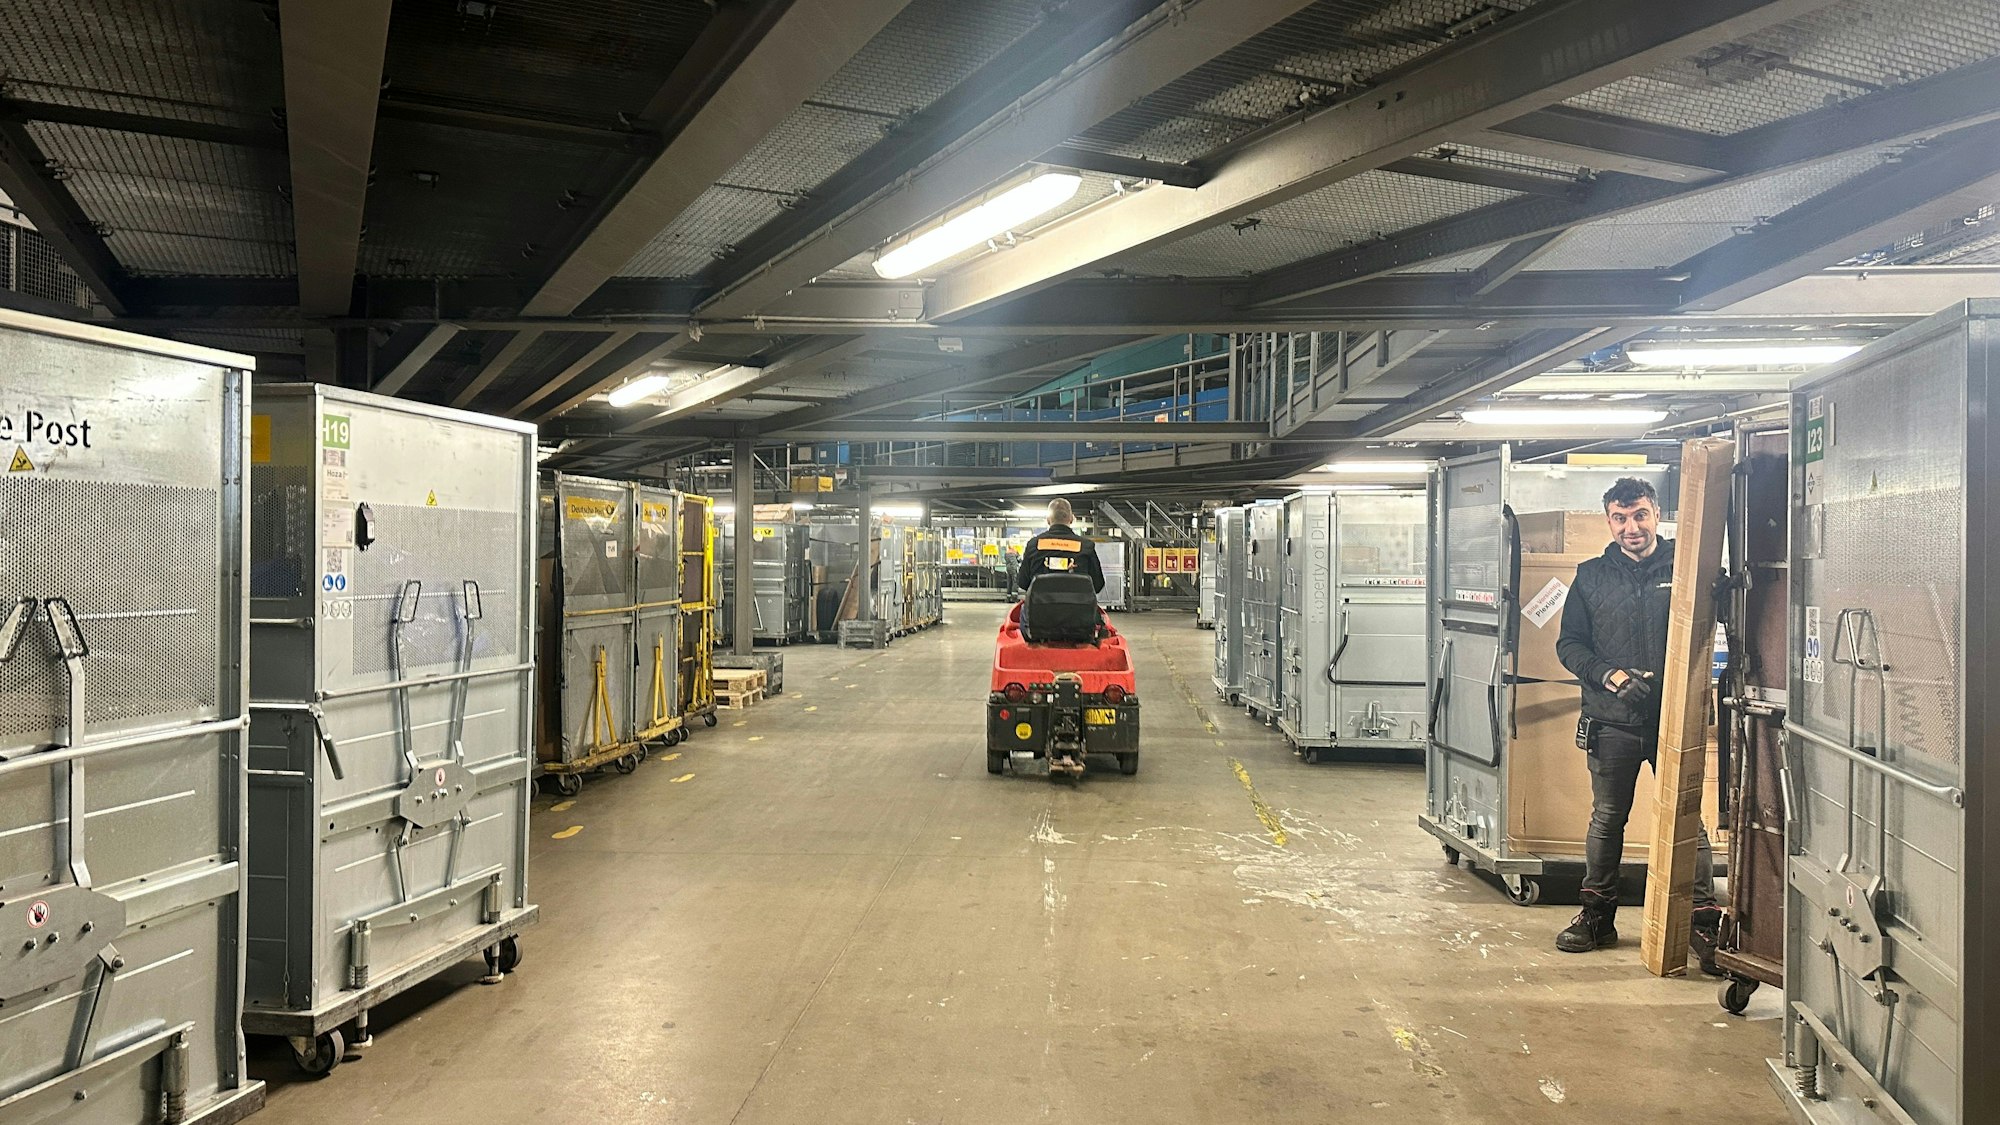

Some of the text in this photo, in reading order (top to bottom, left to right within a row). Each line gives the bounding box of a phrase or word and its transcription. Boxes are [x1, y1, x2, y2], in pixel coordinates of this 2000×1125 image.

[26, 410, 92, 449] Post
[322, 419, 349, 444] H19
[1311, 510, 1325, 541] DHL
[1310, 563, 1329, 624] Property
